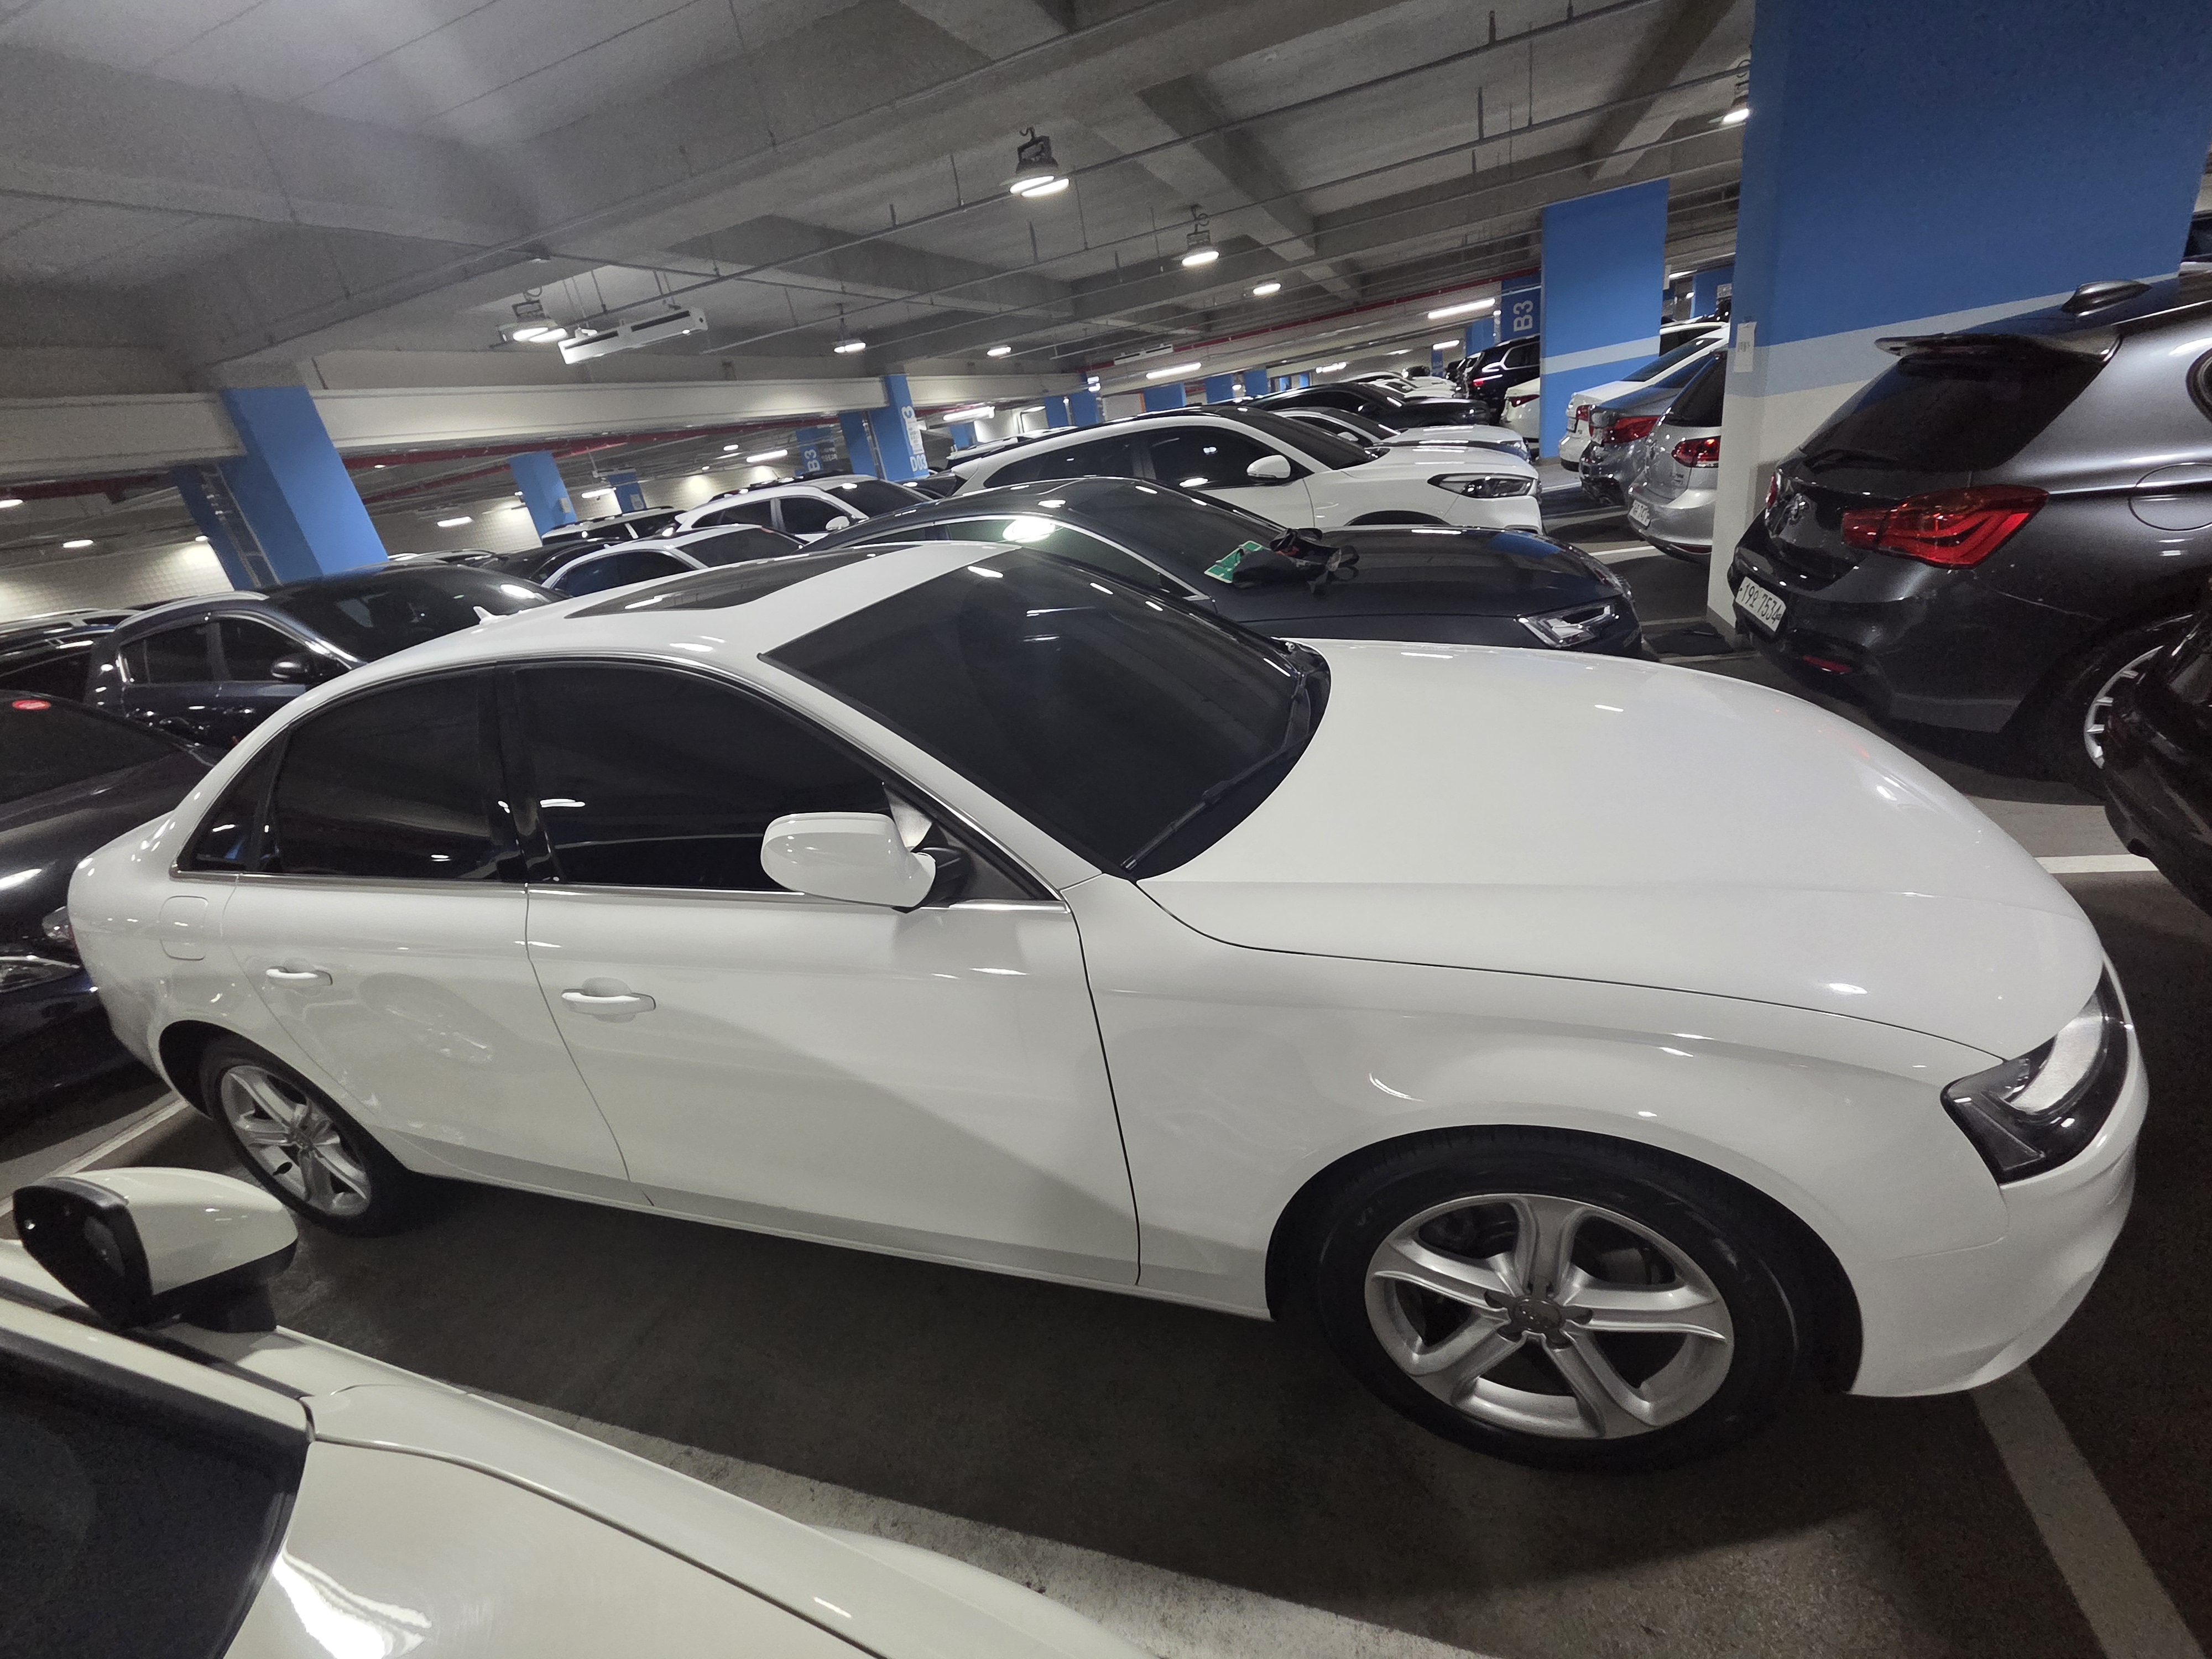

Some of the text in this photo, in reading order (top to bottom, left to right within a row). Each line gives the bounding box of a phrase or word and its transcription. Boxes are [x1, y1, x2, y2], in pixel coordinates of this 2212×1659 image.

[1513, 300, 1533, 332] B3
[804, 449, 821, 472] B3
[910, 454, 928, 472] D03
